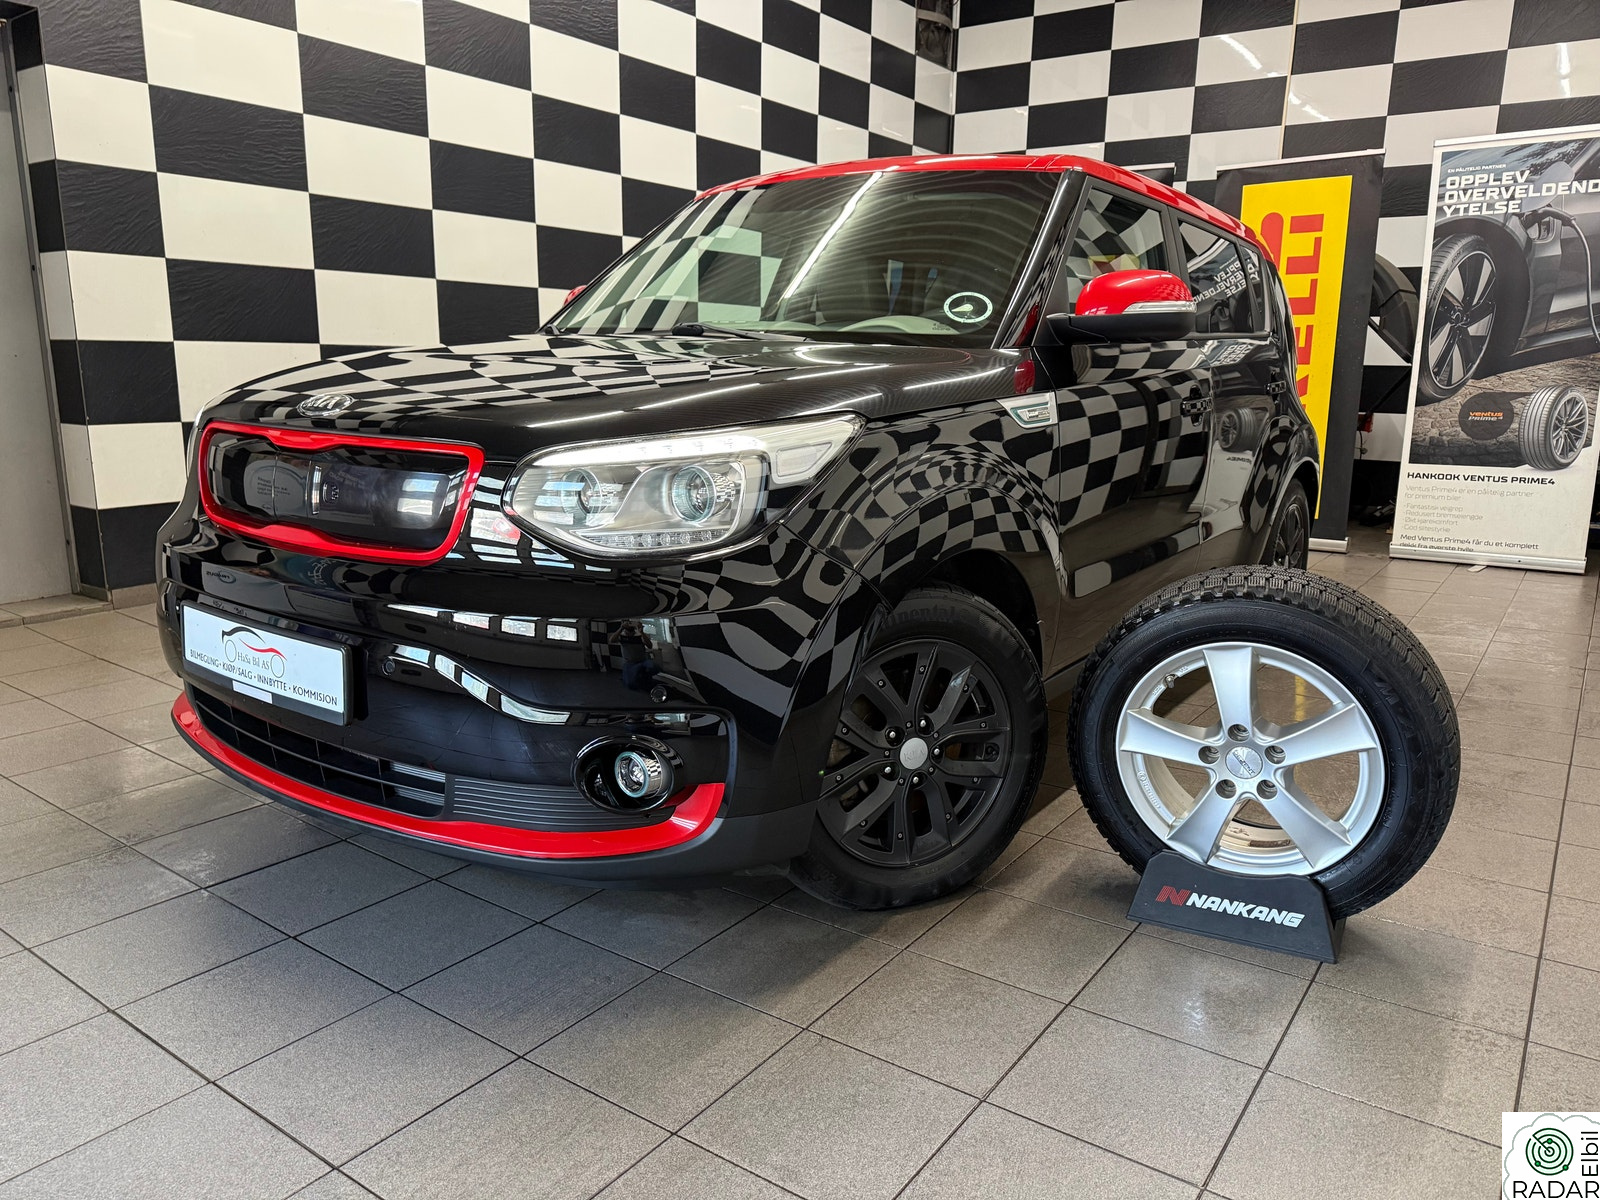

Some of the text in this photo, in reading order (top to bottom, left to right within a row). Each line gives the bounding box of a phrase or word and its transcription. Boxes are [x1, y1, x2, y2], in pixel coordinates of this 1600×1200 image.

[1446, 170, 1530, 189] OPPLEV
[1444, 178, 1600, 203] OVERVELDEND
[1442, 200, 1522, 218] YTELSE
[1407, 472, 1555, 485] HANKOOK VENTUS PRIME4
[1415, 493, 1446, 501] premium
[1431, 486, 1458, 494] Prime4
[1506, 490, 1534, 498] partner
[1417, 535, 1443, 543] Ventus
[1444, 537, 1471, 545] Prime4
[1504, 541, 1540, 550] komplett
[252, 656, 260, 668] Bil
[261, 659, 270, 670] AS
[257, 673, 287, 691] INNBYTTE
[1186, 892, 1306, 928] NANKANG
